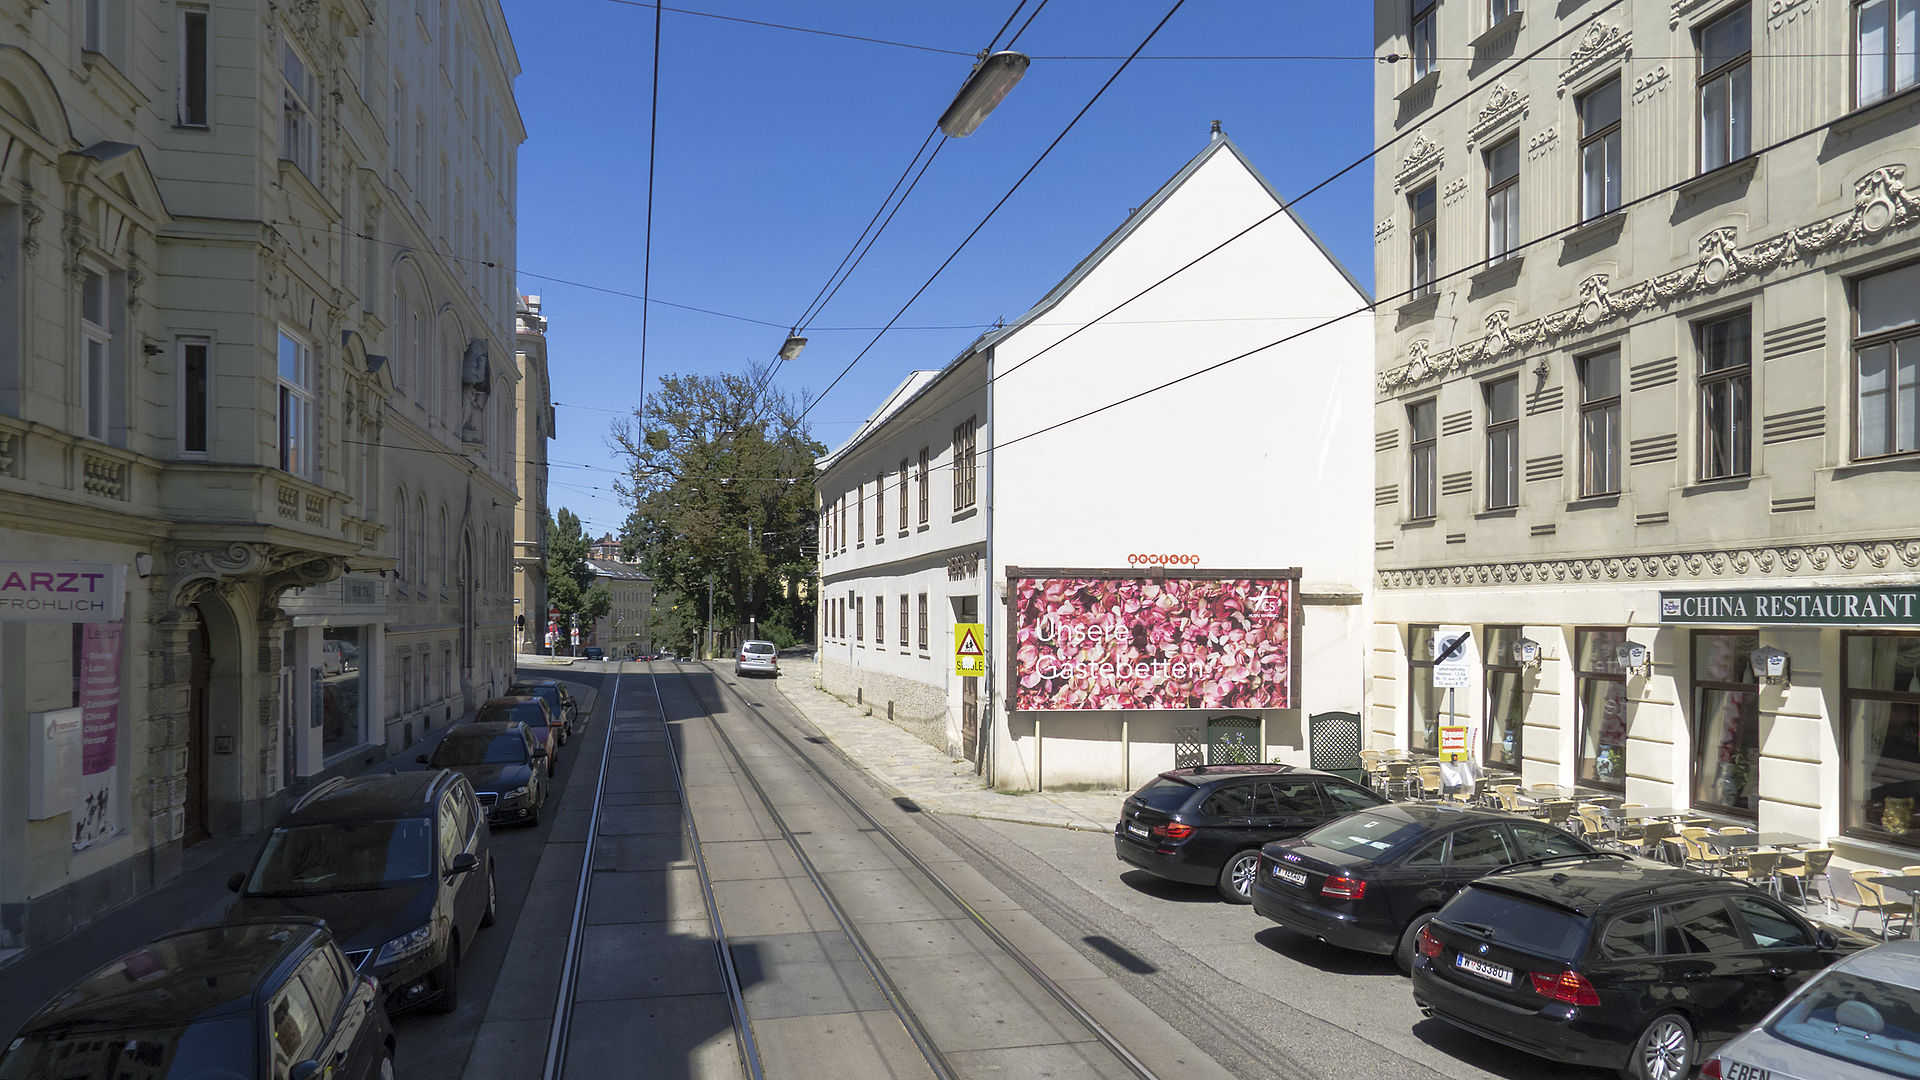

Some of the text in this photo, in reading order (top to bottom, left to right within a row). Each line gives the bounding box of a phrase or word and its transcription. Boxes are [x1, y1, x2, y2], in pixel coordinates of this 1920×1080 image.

[1, 571, 104, 592] ARZT
[1683, 593, 1916, 618] CHINA RESTAURANT
[1036, 617, 1130, 643] Unsere
[956, 660, 983, 671] SCLE
[1035, 654, 1211, 680] Gästebetten.
